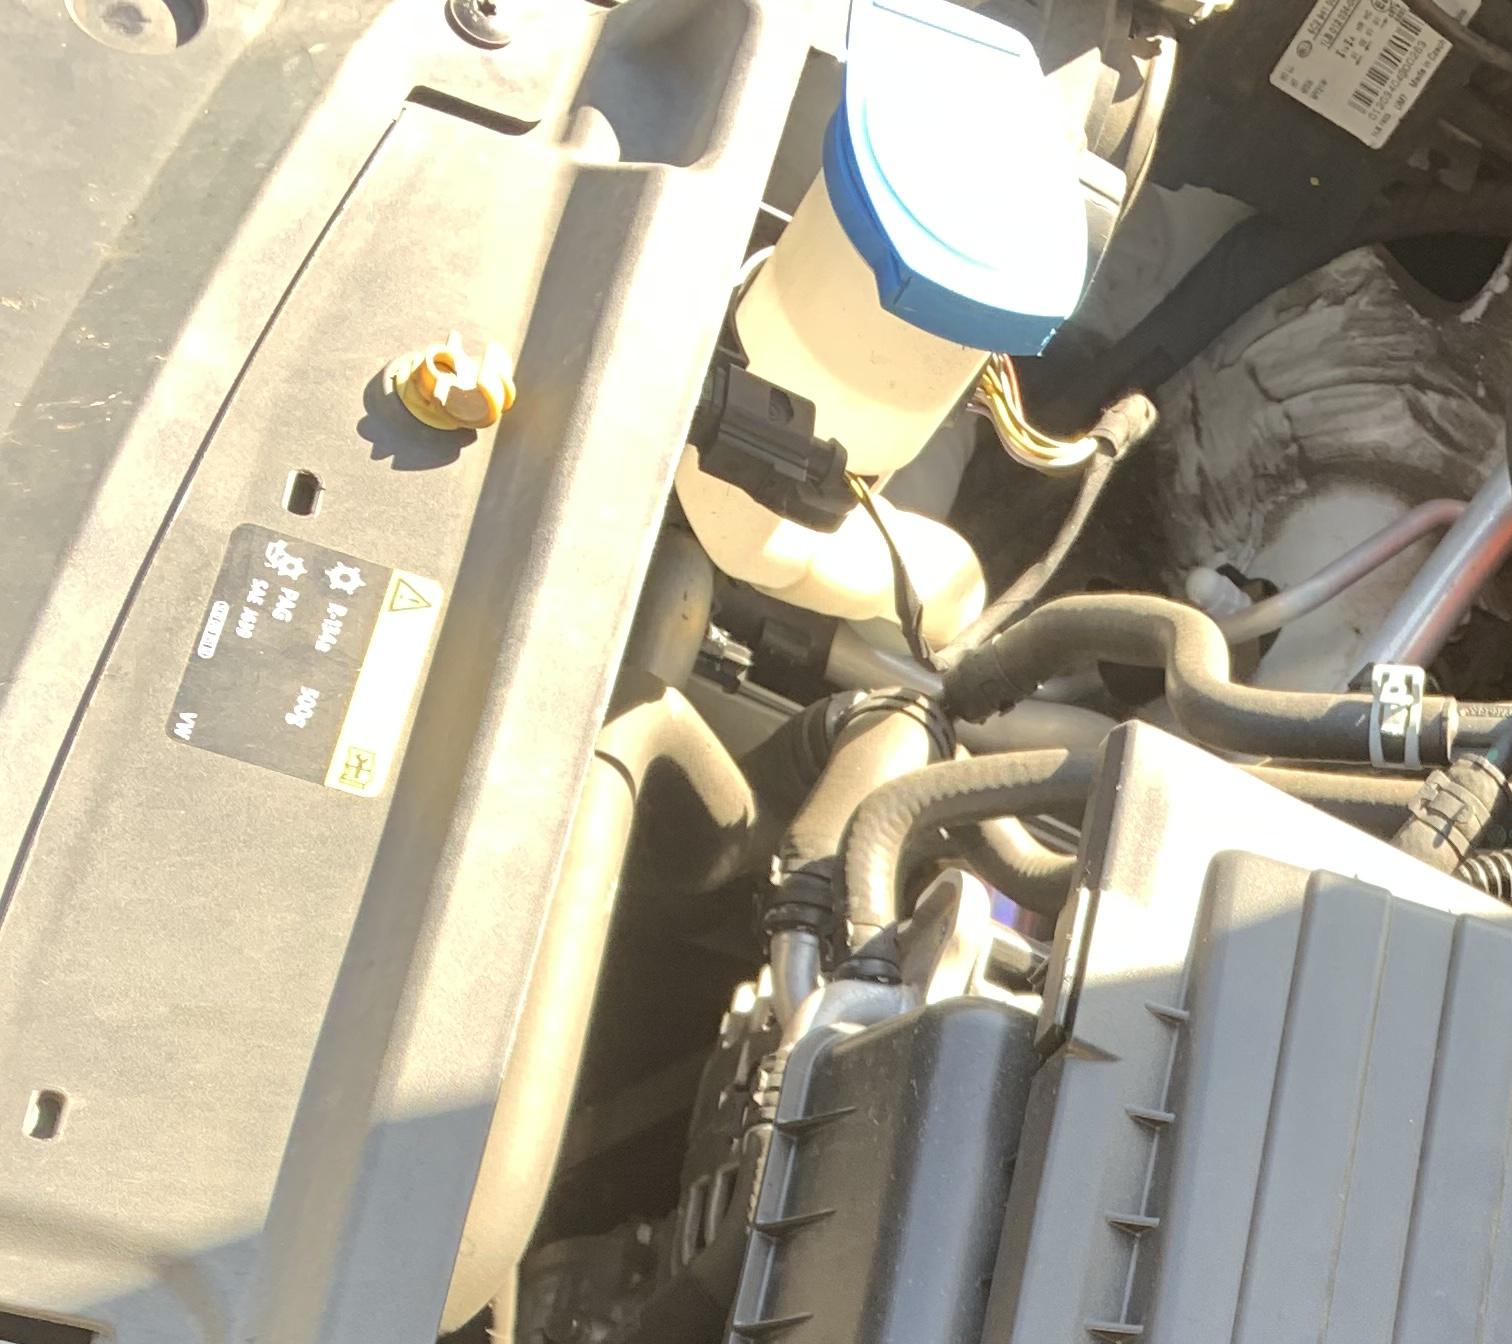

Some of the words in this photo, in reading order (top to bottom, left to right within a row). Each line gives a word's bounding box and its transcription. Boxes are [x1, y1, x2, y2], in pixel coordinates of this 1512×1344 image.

[244, 577, 269, 606] SAE
[270, 586, 300, 623] PAG
[171, 709, 197, 741] VW
